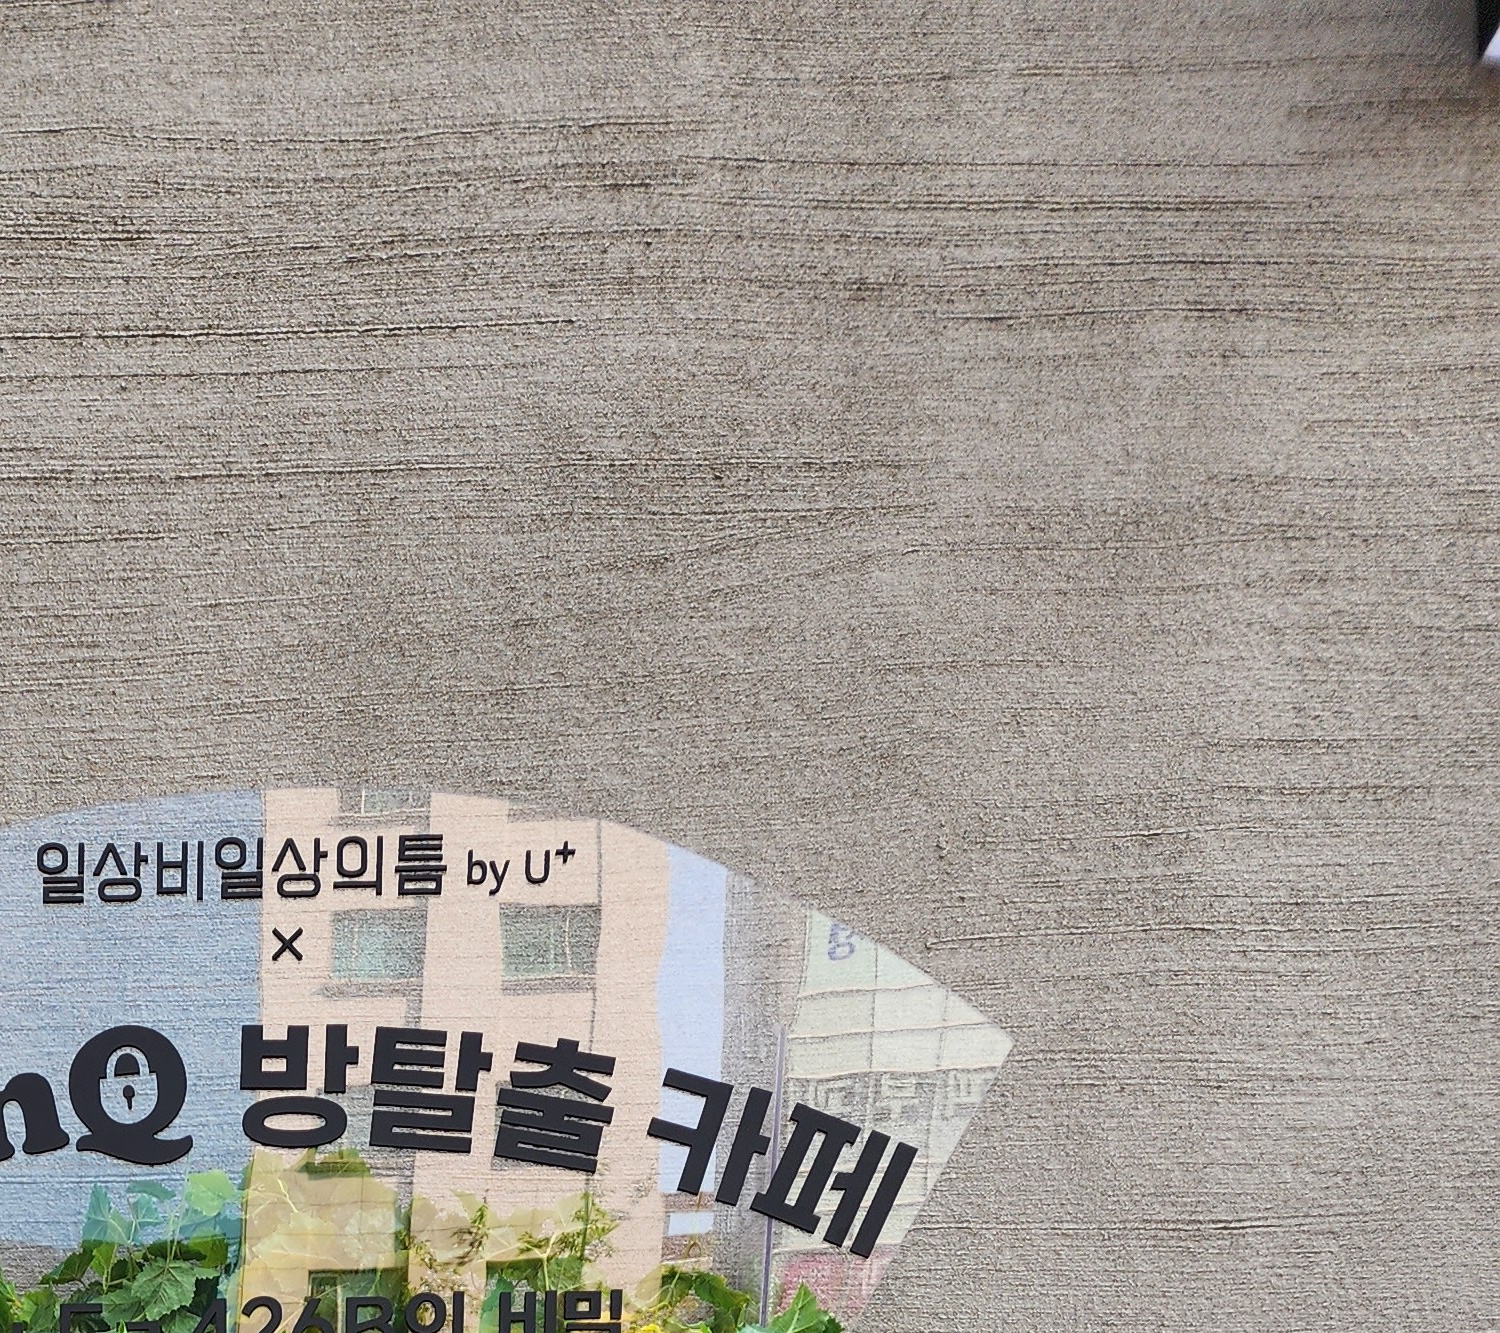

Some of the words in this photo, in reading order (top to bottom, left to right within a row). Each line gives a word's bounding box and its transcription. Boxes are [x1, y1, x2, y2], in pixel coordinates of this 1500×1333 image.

[36, 834, 447, 904] 일상비일상의틈
[466, 849, 510, 896] by
[239, 1023, 617, 1174] 방탈출
[647, 1067, 920, 1259] 카페
